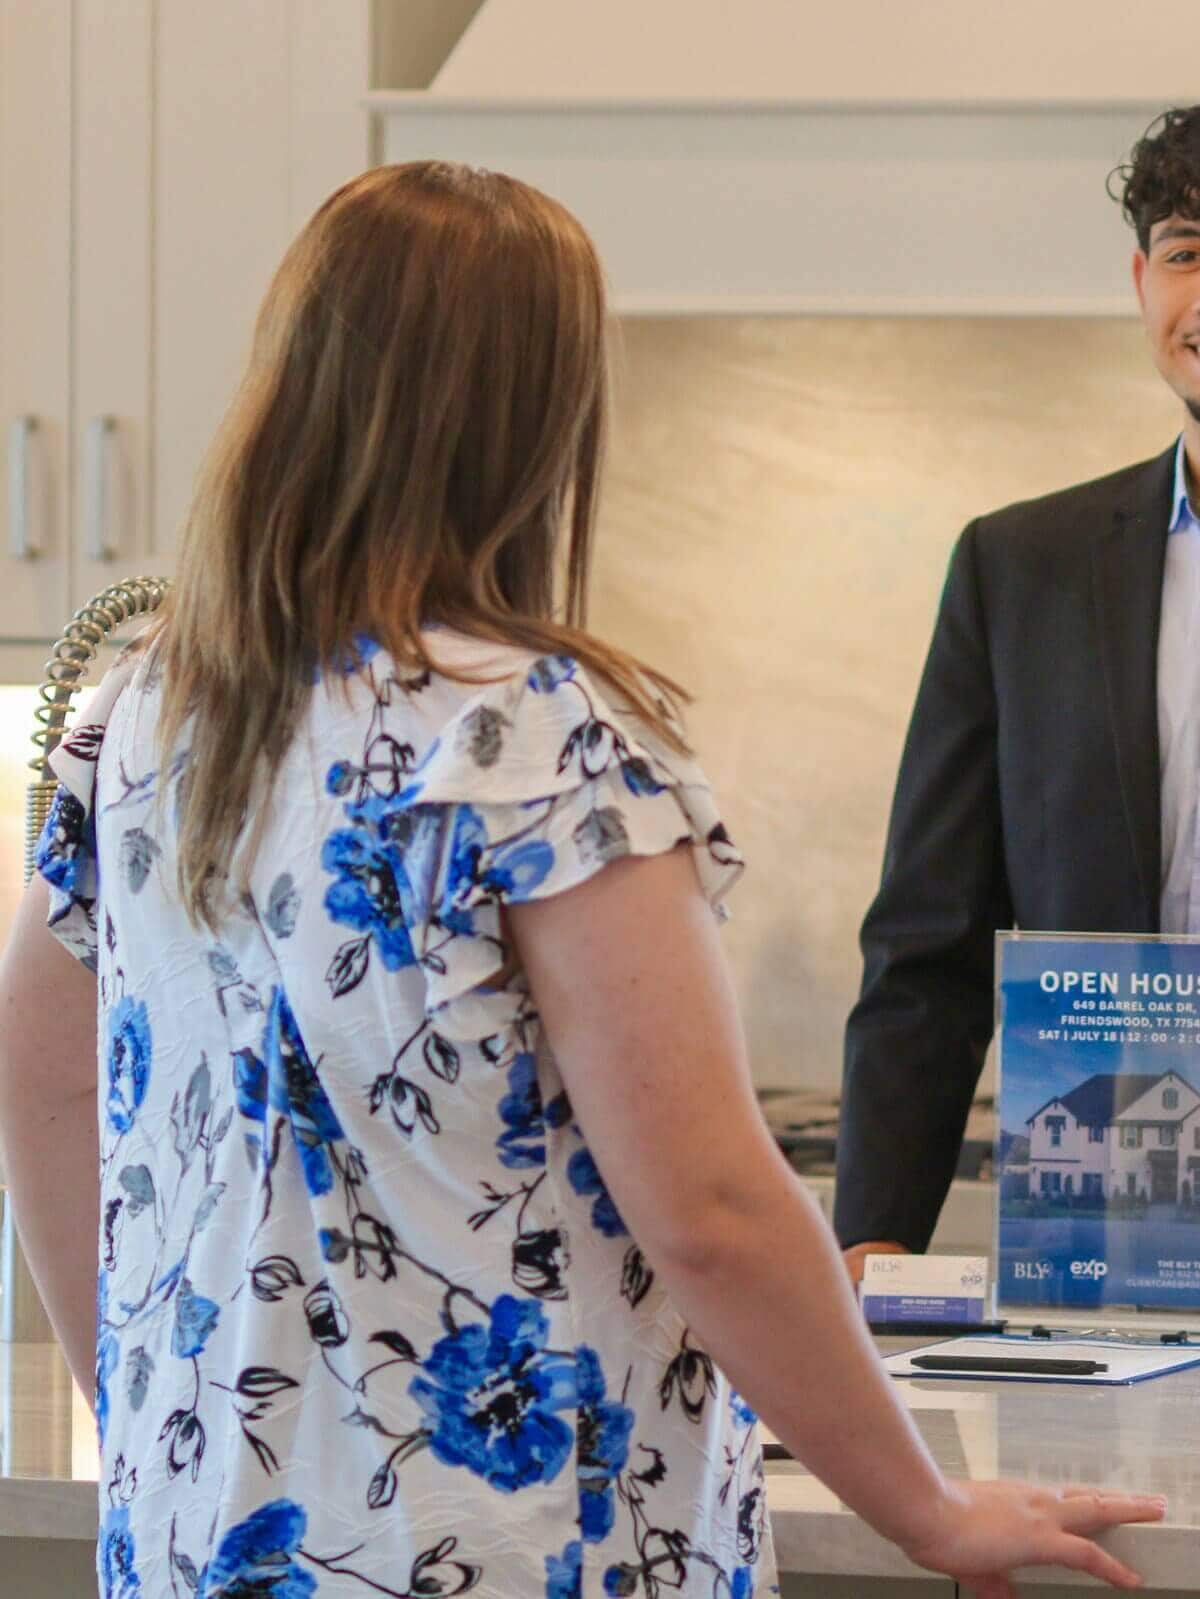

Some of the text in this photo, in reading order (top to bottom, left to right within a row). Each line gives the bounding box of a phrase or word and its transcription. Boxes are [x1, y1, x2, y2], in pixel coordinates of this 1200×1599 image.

[1039, 970, 1119, 994] OPEN
[1073, 1000, 1095, 1010] 649
[1099, 1001, 1145, 1012] BARREL
[1148, 1002, 1173, 1013] OAK
[1061, 1015, 1153, 1029] FRIENDSWOOD,
[1156, 1017, 1171, 1028] TX
[1039, 1030, 1060, 1041] SAT
[1071, 1031, 1100, 1042] JULY
[1103, 1031, 1117, 1042] 18
[1070, 1259, 1108, 1280] exp
